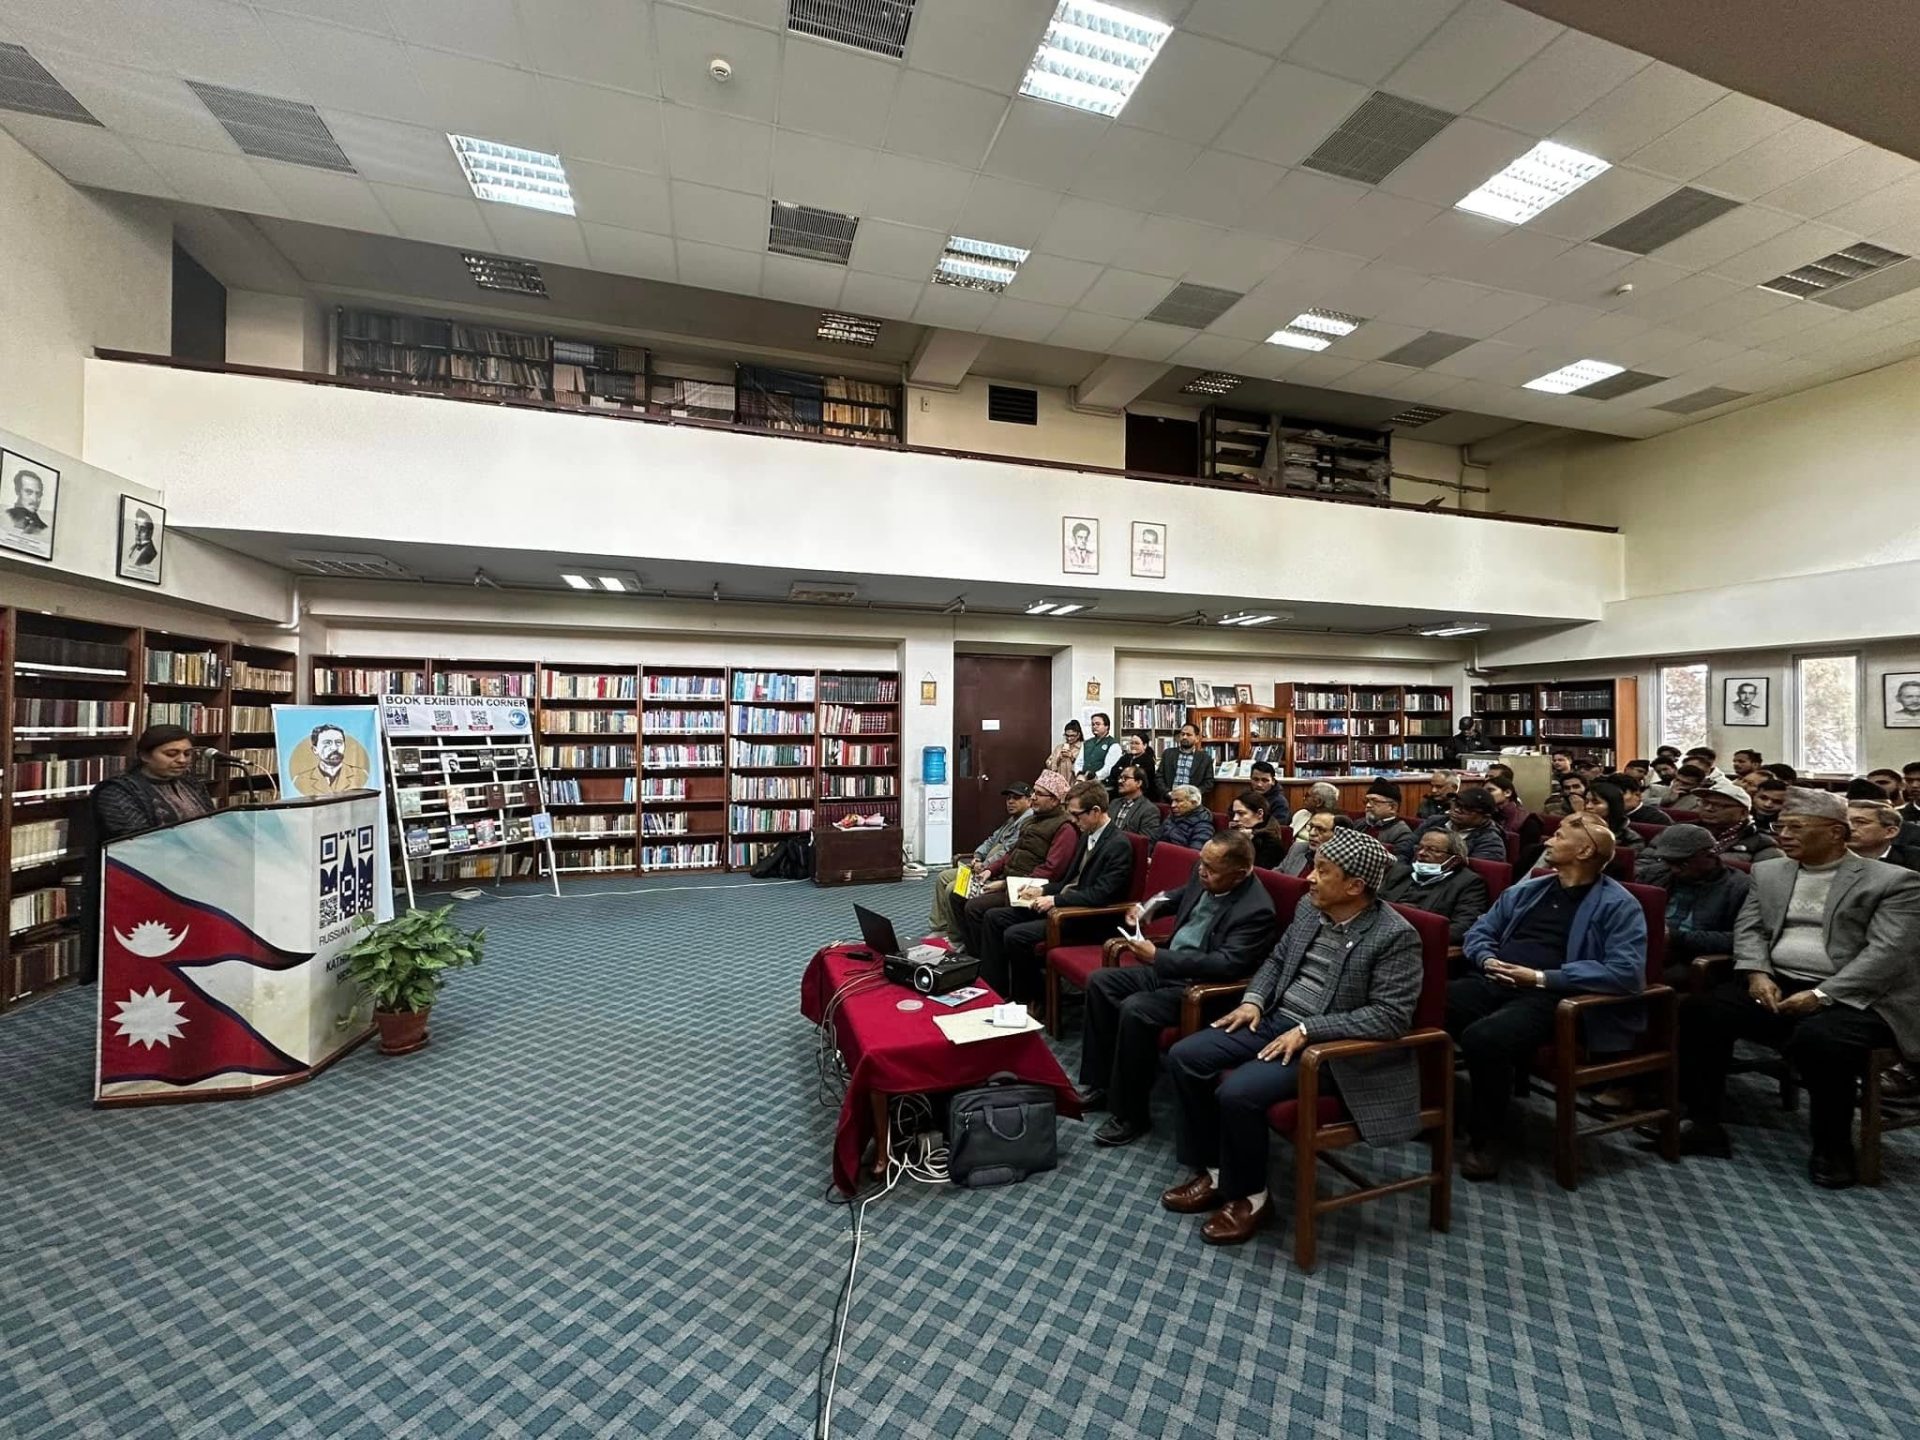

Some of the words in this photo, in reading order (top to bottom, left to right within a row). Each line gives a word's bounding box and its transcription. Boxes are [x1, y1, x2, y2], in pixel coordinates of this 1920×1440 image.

[385, 696, 421, 705] BOOK
[424, 697, 483, 706] EXHIBITION
[486, 699, 526, 707] CORNER
[319, 925, 350, 946] RUSSIAN
